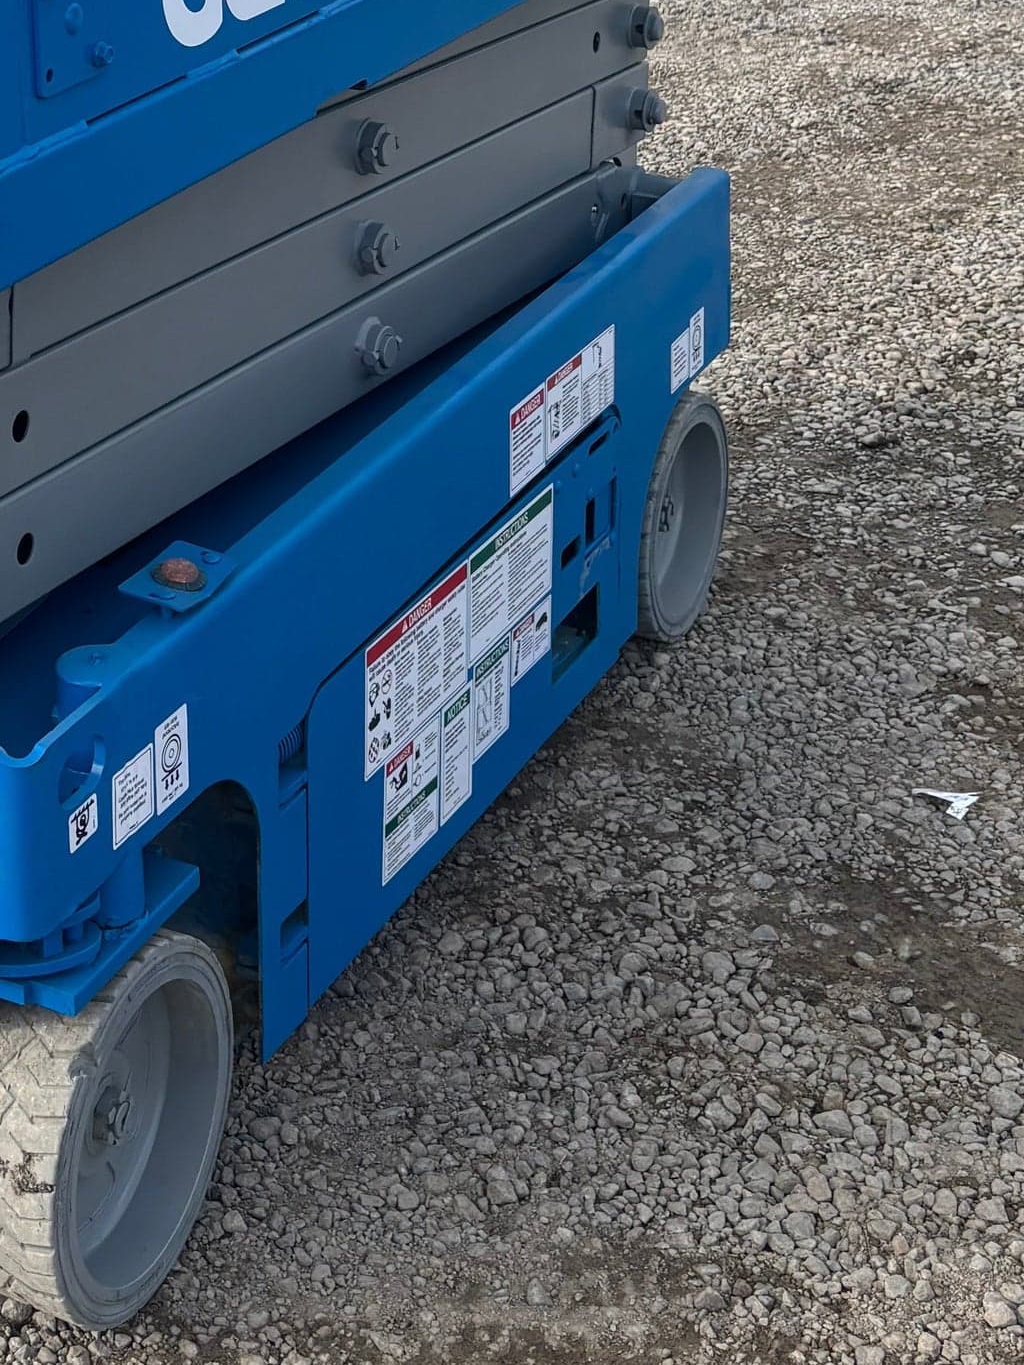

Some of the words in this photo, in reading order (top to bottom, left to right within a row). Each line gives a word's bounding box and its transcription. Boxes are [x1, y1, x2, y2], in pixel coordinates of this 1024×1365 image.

[520, 394, 541, 419] DANGER
[408, 597, 432, 627] DANGER
[447, 693, 468, 722] NOTICE
